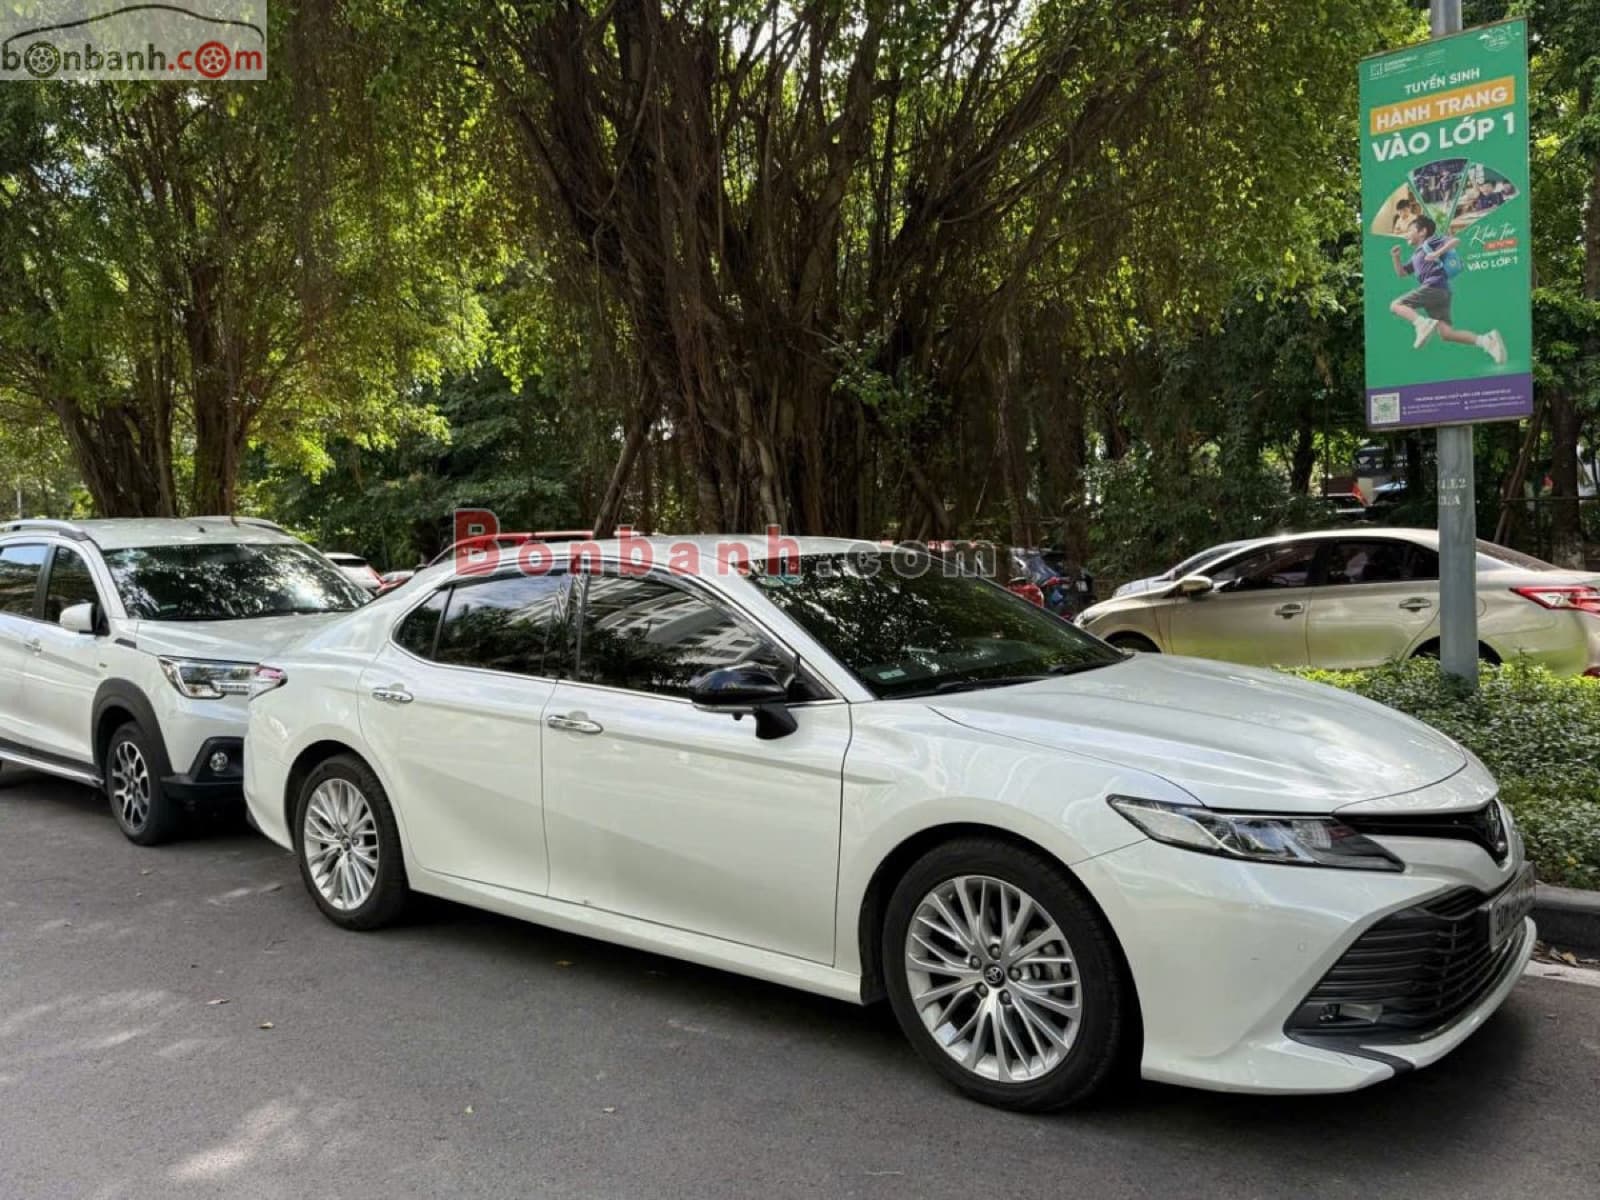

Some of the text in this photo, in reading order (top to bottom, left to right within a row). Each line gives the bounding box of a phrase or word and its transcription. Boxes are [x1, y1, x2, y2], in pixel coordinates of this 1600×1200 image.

[1449, 68, 1481, 85] SINH
[1376, 87, 1508, 131] HÀNH TRANG
[1372, 111, 1515, 162] VÀO LỚP 1
[1467, 259, 1489, 272] VÀO
